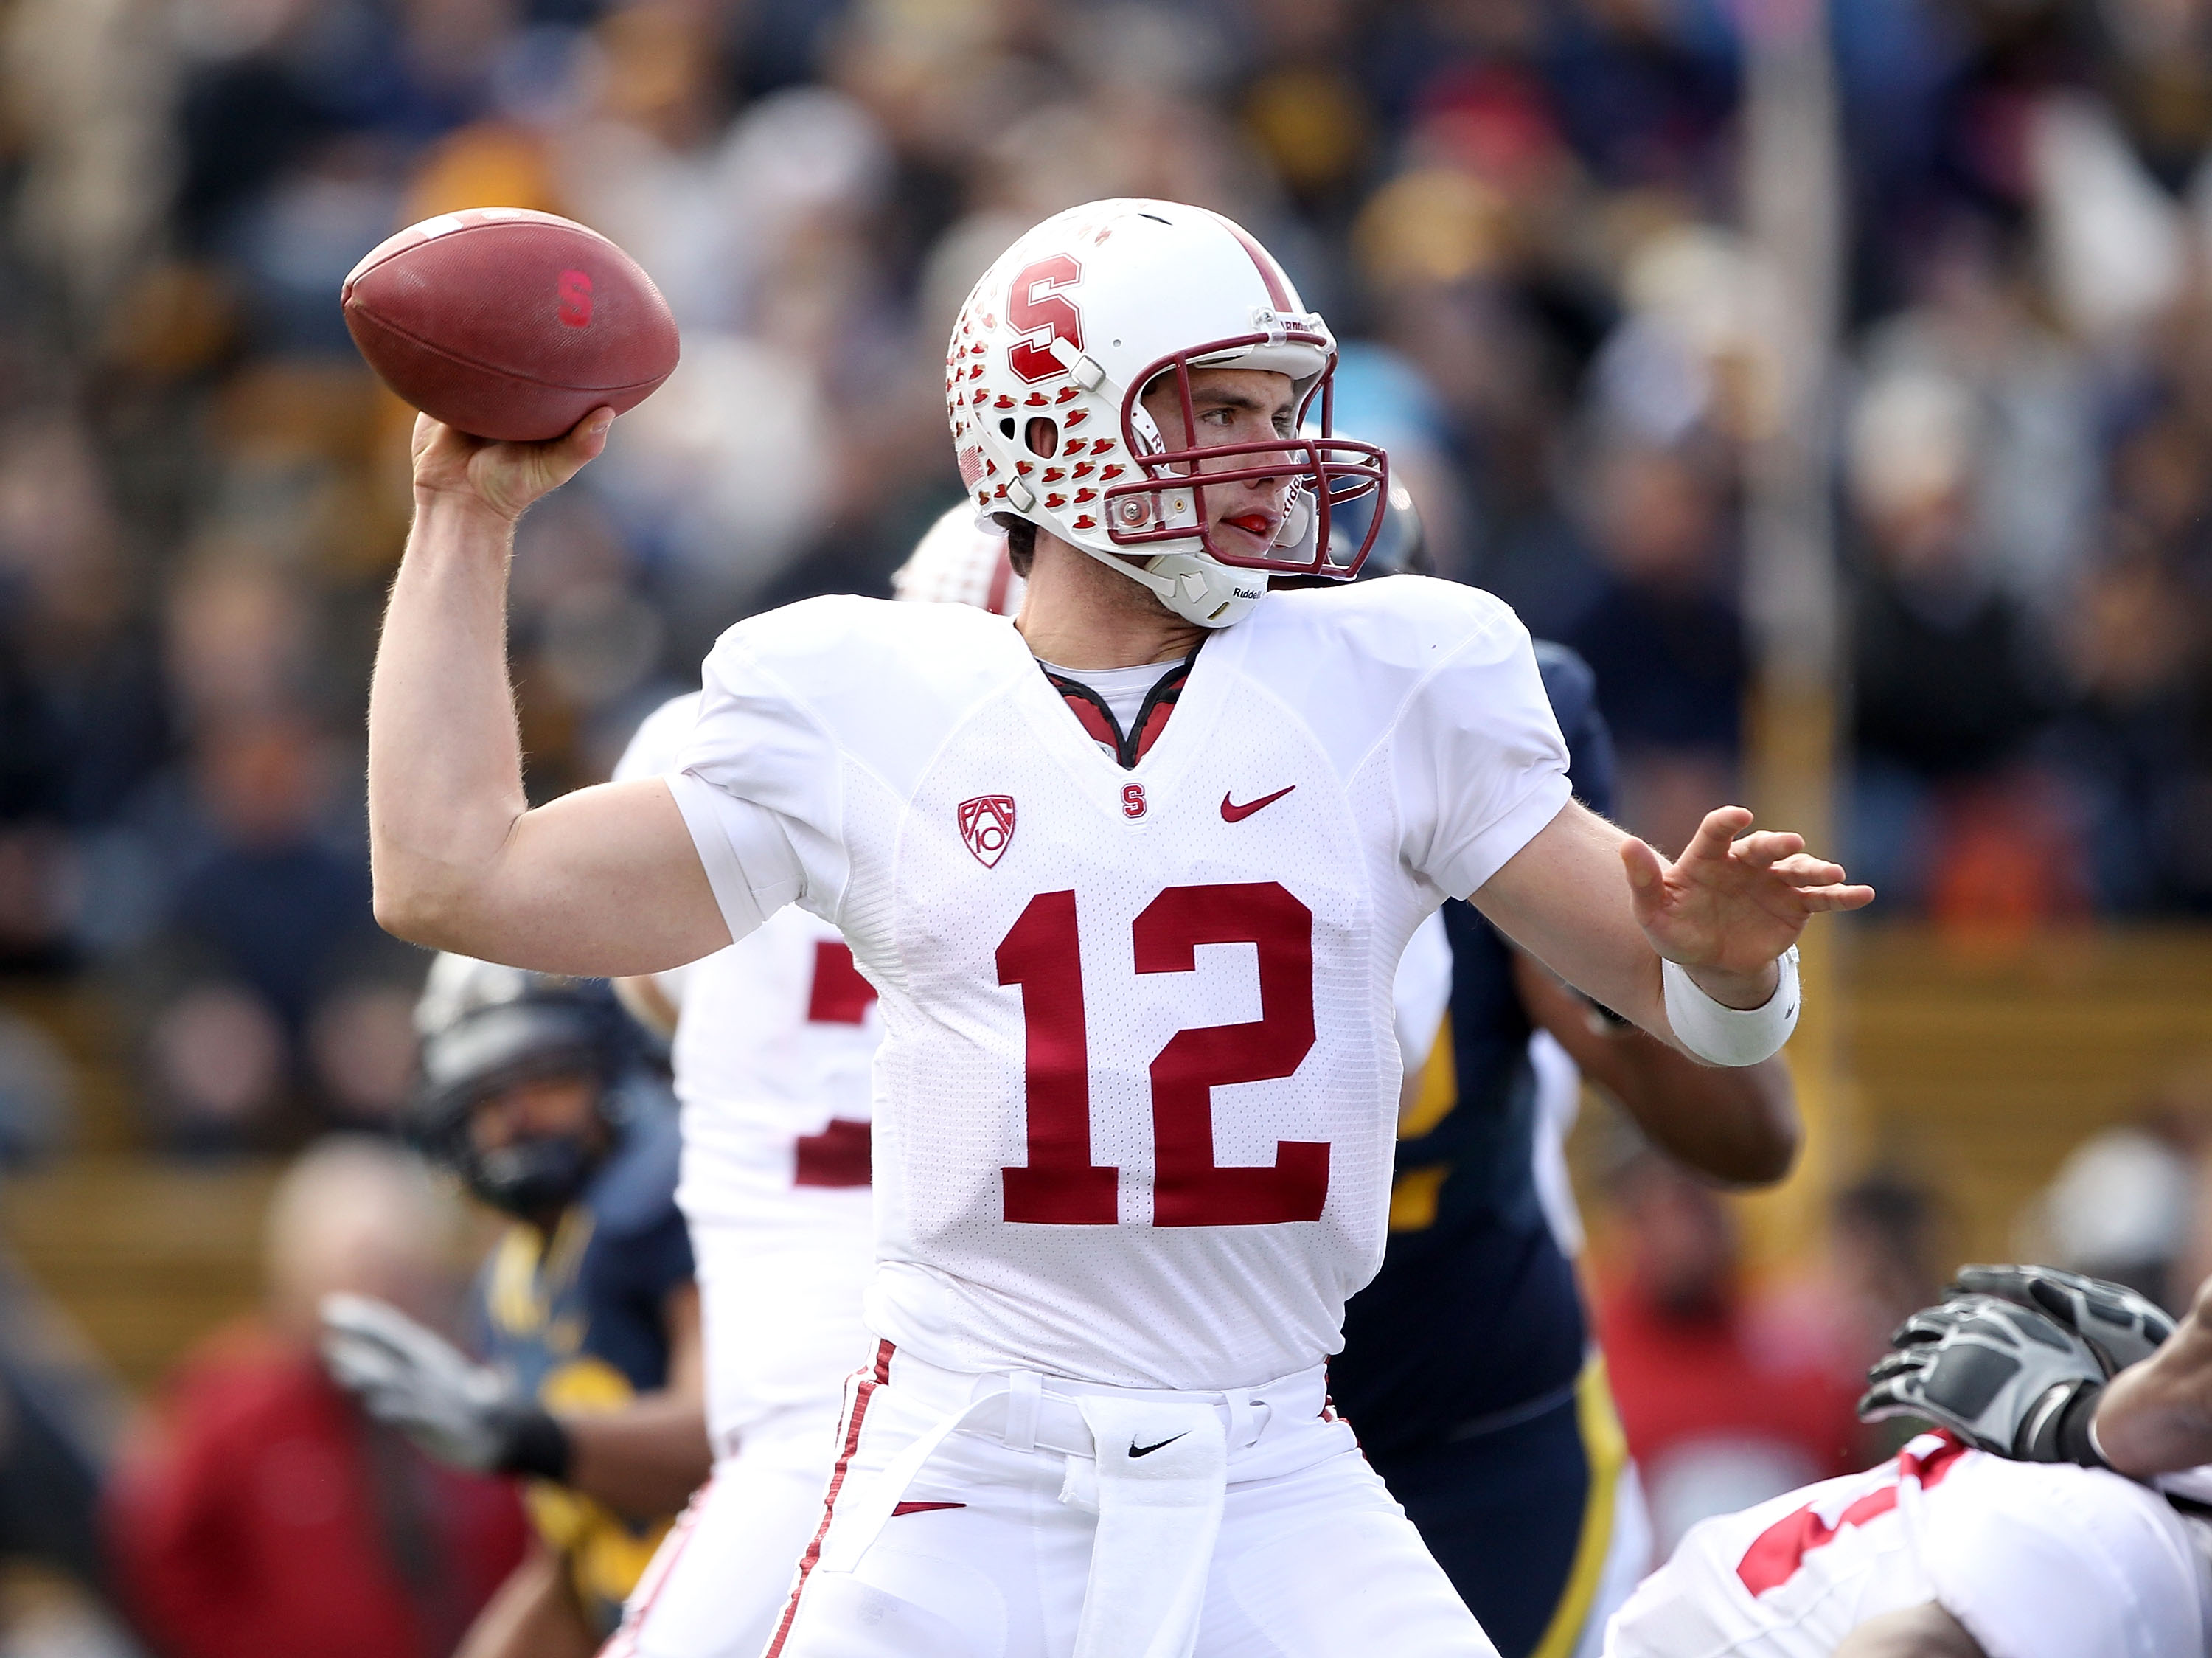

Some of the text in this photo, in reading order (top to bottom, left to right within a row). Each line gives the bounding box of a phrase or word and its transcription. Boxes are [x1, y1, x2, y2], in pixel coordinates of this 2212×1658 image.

[558, 270, 593, 329] S
[1006, 252, 1085, 385] S
[961, 798, 1012, 842] PAC
[1121, 783, 1147, 819] S
[975, 826, 1006, 853] 10
[995, 881, 1331, 1227] 12
